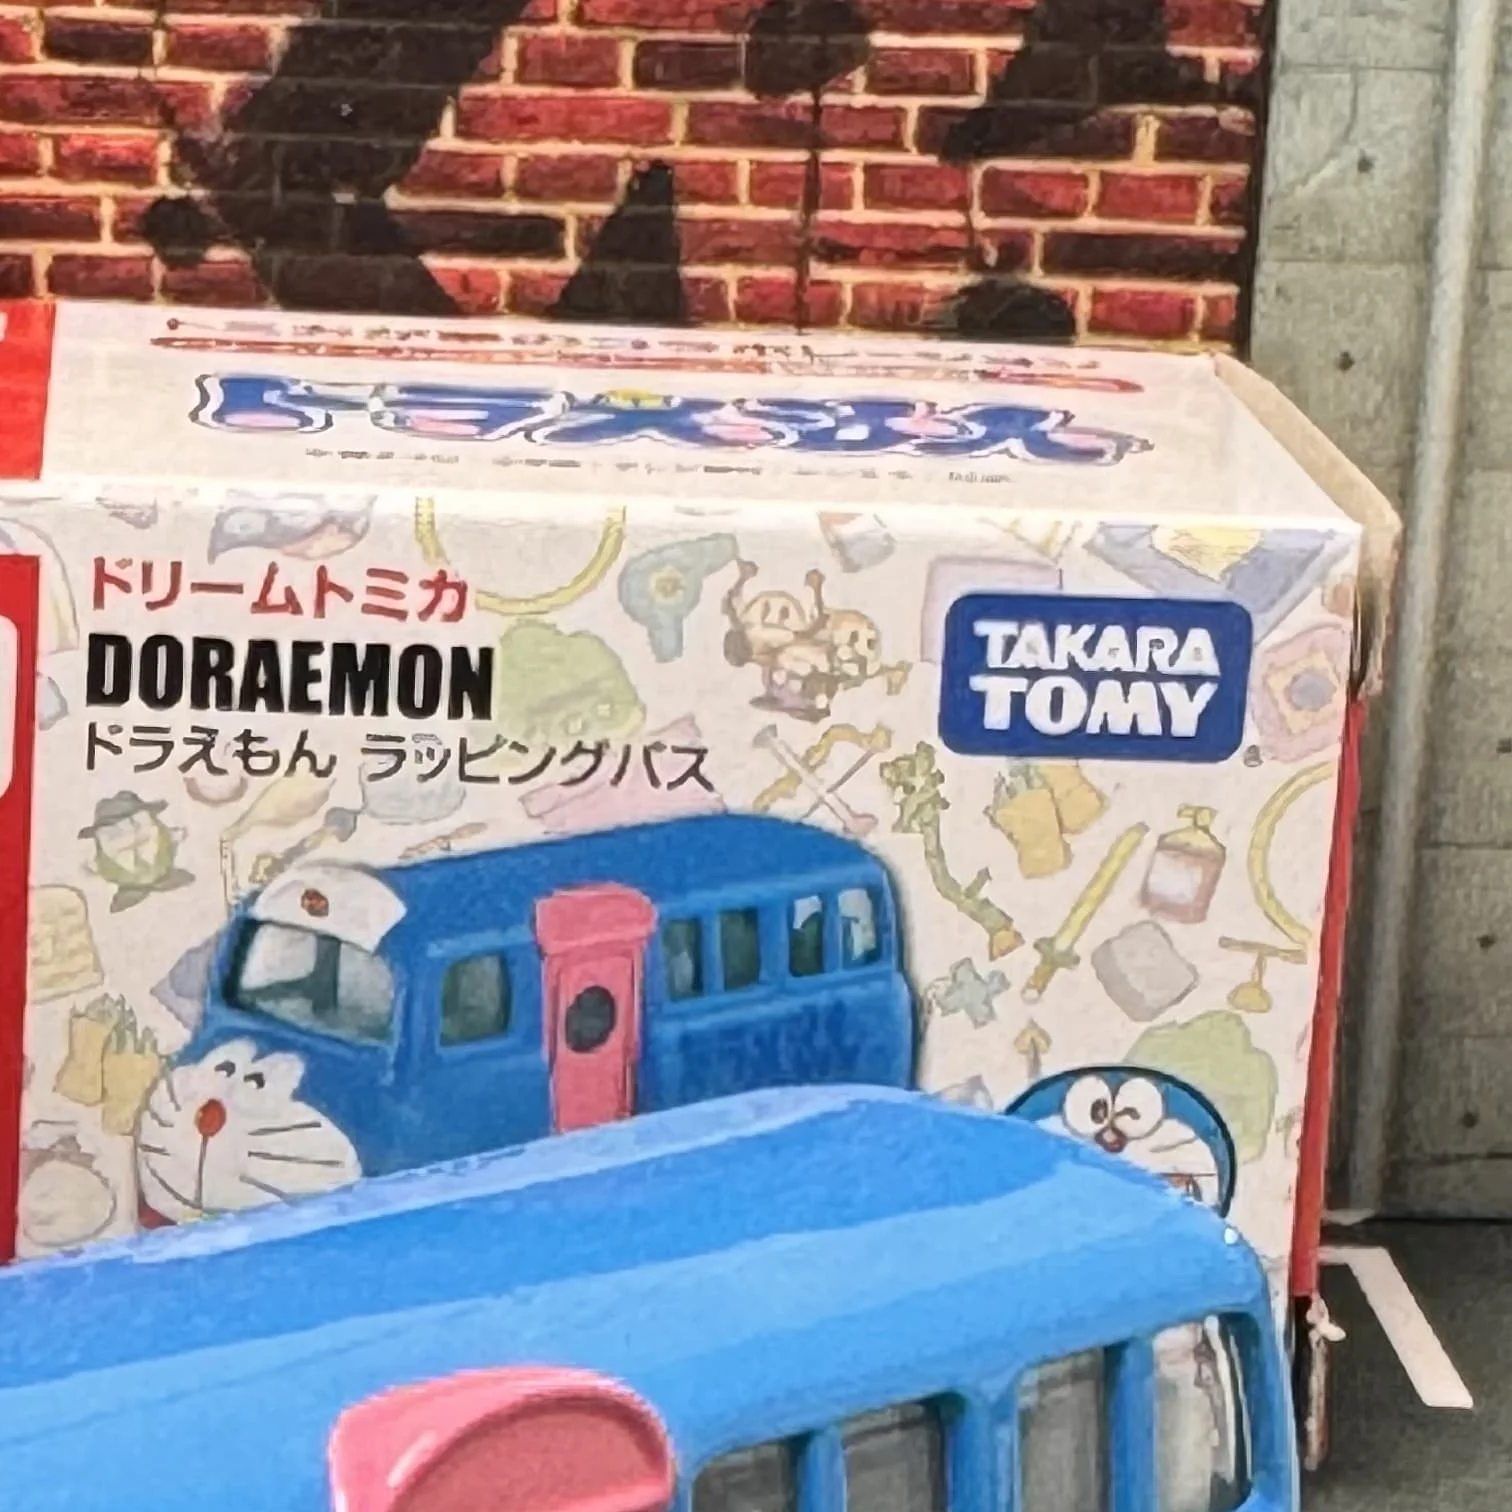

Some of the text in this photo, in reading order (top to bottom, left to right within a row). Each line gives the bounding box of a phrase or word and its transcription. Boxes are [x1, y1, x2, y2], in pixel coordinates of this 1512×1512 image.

[92, 556, 470, 623] ドリームトミカ
[87, 632, 494, 721] DORAEMON
[974, 620, 1221, 677] TAKARA
[969, 675, 1220, 738] TOMY
[86, 721, 715, 792] ドラえもん ラッピングバス
